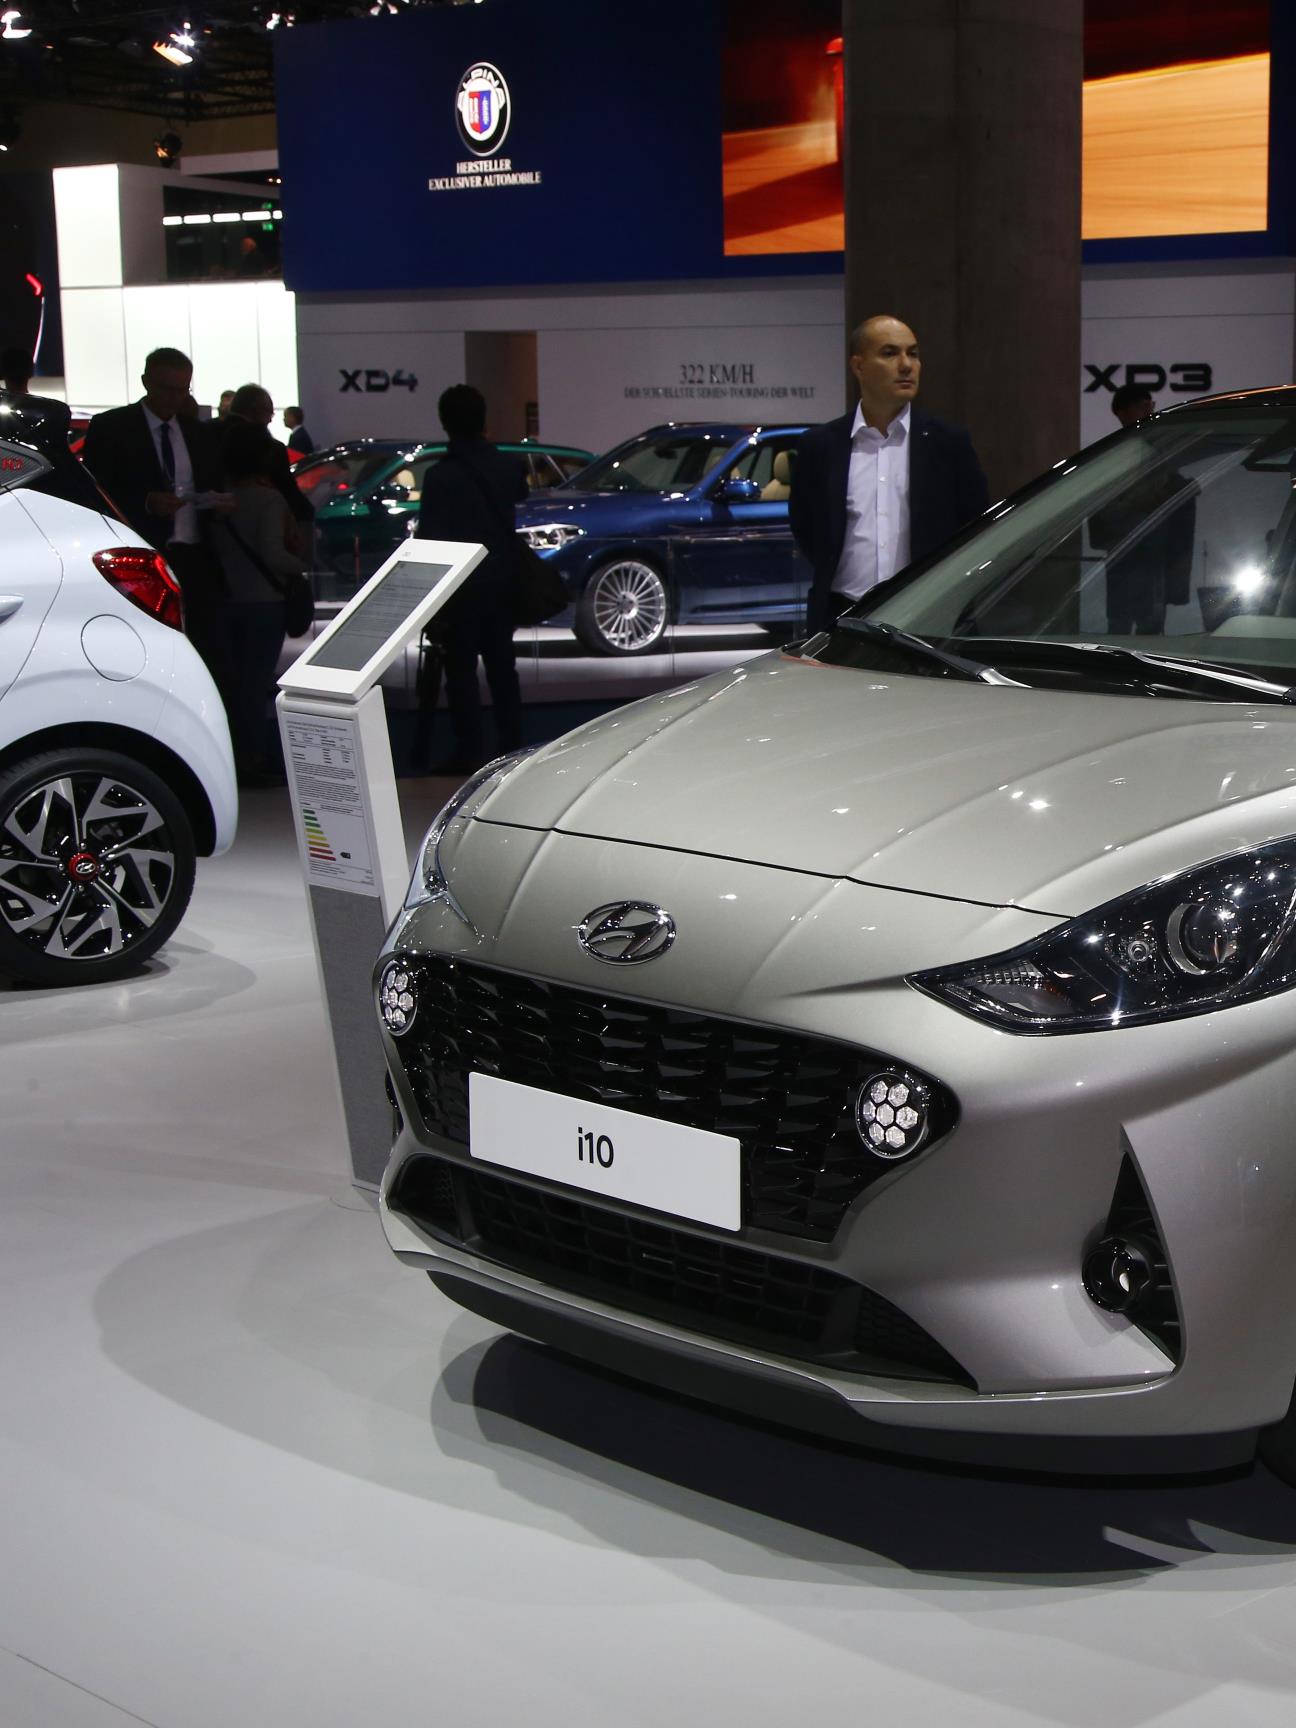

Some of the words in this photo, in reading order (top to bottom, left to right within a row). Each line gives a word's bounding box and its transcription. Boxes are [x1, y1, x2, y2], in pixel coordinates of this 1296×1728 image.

[456, 159, 512, 174] HERSTELLER
[429, 175, 482, 190] EXCLUSIVER
[483, 171, 541, 187] AUTOMOBILE
[339, 369, 418, 392] XD4
[680, 364, 704, 384] 322
[709, 364, 755, 384] KM/H
[1083, 363, 1212, 392] XD3
[642, 387, 695, 399] SCHELLSTE
[771, 387, 788, 399] DER
[790, 387, 815, 399] WELT
[578, 1126, 614, 1168] i10
